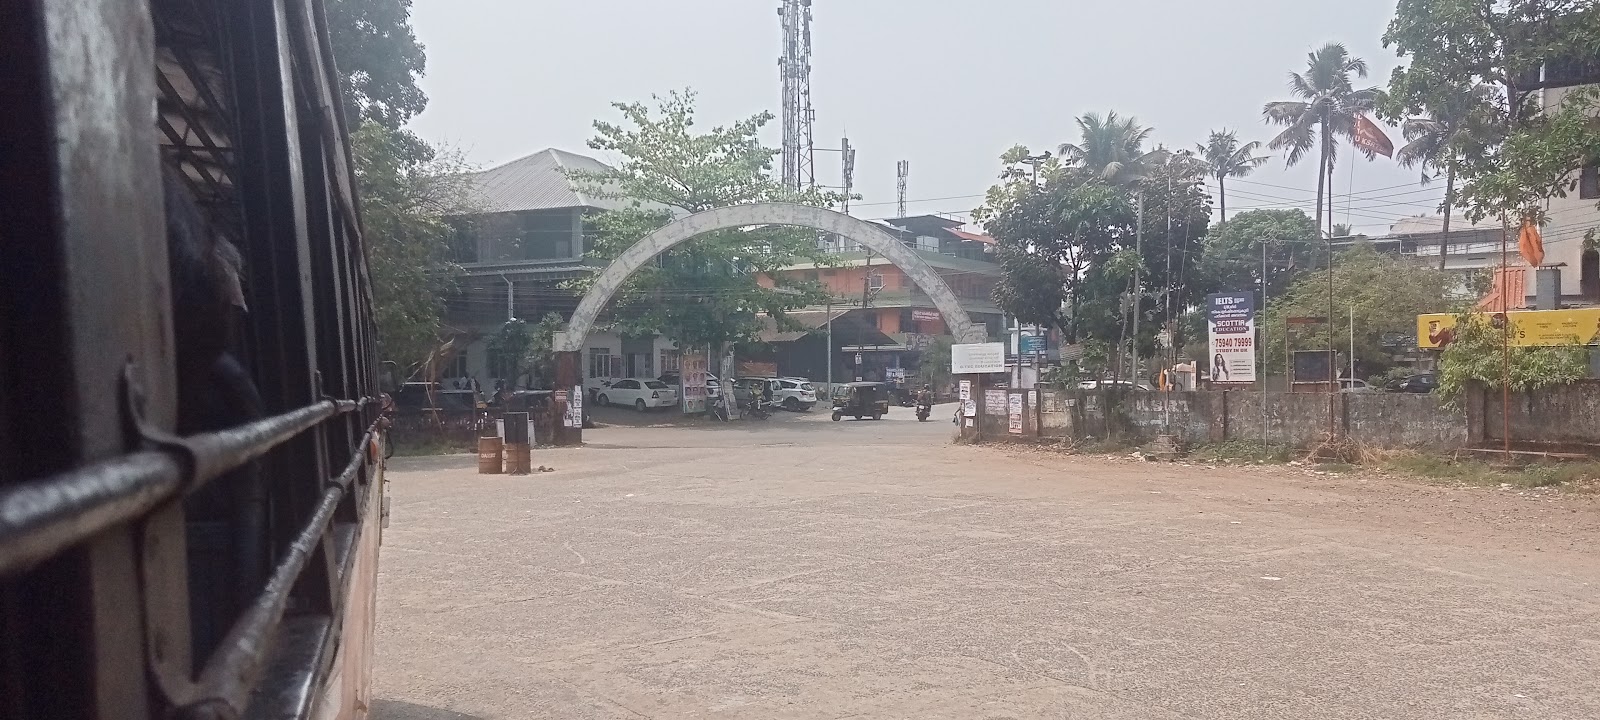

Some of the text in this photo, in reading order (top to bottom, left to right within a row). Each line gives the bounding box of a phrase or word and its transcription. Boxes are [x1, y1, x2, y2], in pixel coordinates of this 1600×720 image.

[1215, 297, 1233, 305] IELTS
[1215, 337, 1252, 347] 75940 79999
